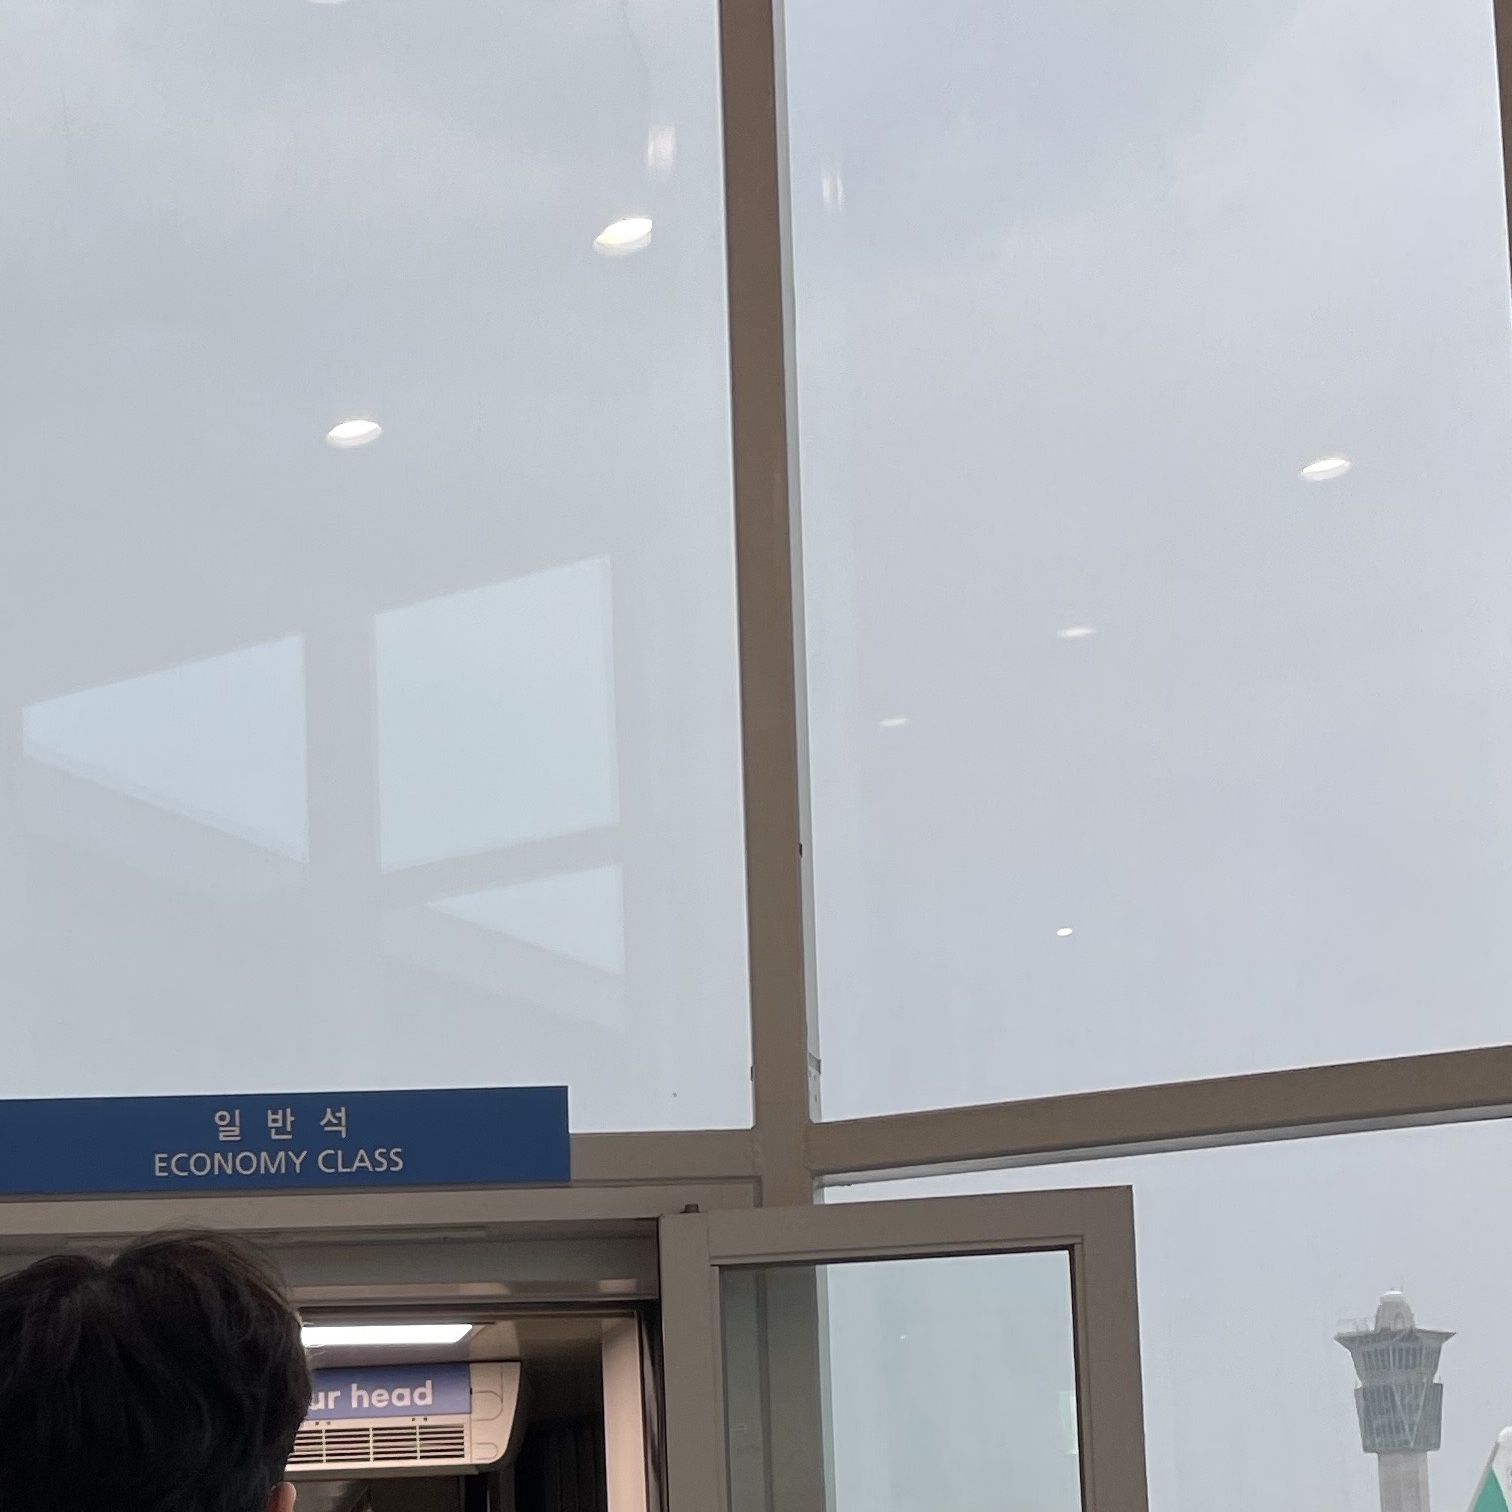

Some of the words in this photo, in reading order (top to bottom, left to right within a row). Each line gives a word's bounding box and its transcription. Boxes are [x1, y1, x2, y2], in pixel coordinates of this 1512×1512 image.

[153, 1150, 308, 1177] ECONOMY
[317, 1147, 405, 1174] CLASS
[350, 1379, 434, 1409] head
